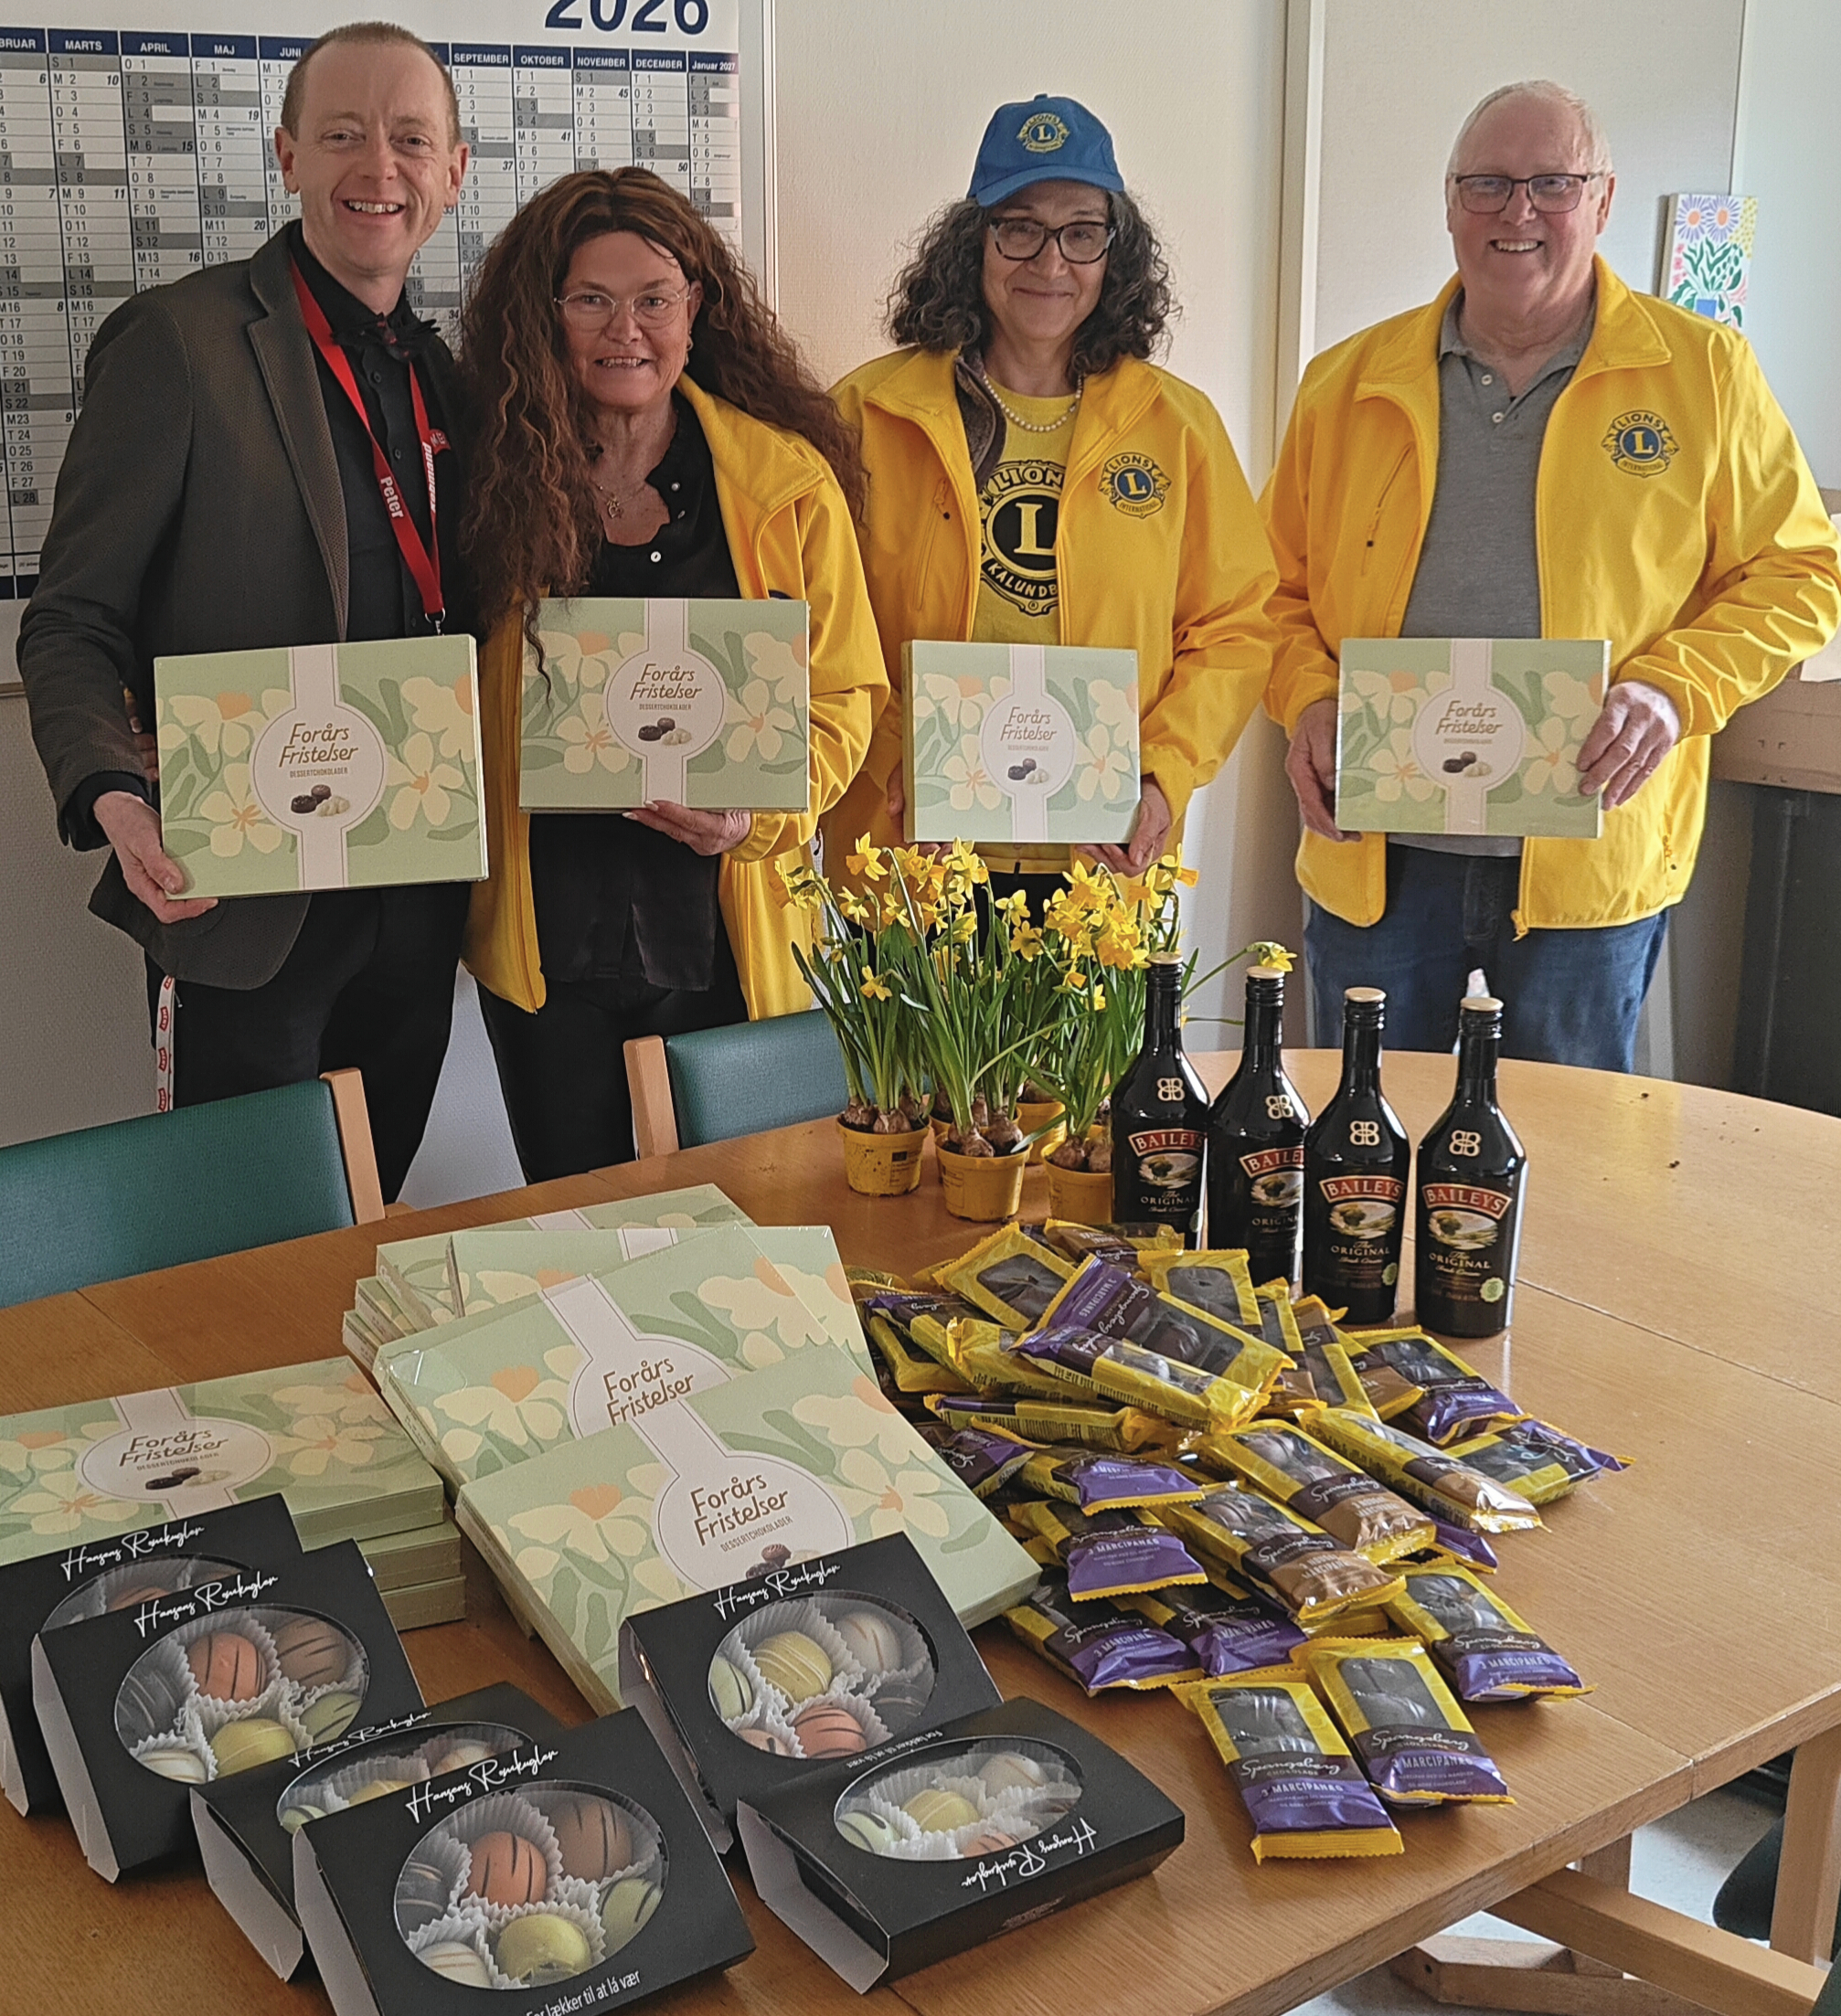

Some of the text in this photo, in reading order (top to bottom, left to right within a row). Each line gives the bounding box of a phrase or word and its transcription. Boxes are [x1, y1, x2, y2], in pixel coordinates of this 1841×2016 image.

[545, 0, 709, 35] 2026
[65, 39, 102, 51] MARTS
[140, 43, 171, 53] APRIL
[214, 45, 235, 55] MAJ
[279, 47, 302, 58] JUNI
[52, 57, 74, 69] S 1
[195, 61, 200, 70] F
[211, 61, 216, 71] 1
[454, 53, 509, 64] SEPTEMBER
[520, 56, 564, 66] OKTOBER
[577, 57, 626, 68] NOVEMBER
[635, 58, 683, 69] DECEMBER
[692, 61, 736, 72] Januar 2027
[54, 74, 119, 86] M 2 10
[577, 88, 629, 98] M 2 45
[198, 110, 259, 121] M 4 19
[518, 131, 526, 141] M
[531, 132, 537, 141] 5
[561, 132, 571, 142] 41
[693, 134, 709, 143] T 5
[1038, 125, 1051, 140] L
[130, 141, 139, 152] M
[145, 141, 152, 152] 6
[182, 141, 193, 152] 15
[200, 142, 221, 152] O 6
[473, 162, 513, 171] 7 37
[62, 188, 125, 199] M 9 11
[461, 206, 480, 215] T 10
[205, 220, 265, 230] M 11 20
[137, 251, 200, 263] M 13 16
[6, 412, 72, 425] M 23 9
[1617, 413, 1662, 428] LIONS
[9, 445, 32, 456] O 25
[1632, 431, 1655, 453] L
[1111, 455, 1150, 472] LIONS
[996, 467, 1063, 491] LION
[1124, 472, 1146, 495] L
[380, 476, 404, 518] Peter
[1014, 503, 1058, 556] L
[987, 562, 1059, 599] KALUNDB
[640, 663, 695, 682] Forårs
[630, 682, 702, 701] Fristelser
[1008, 706, 1051, 724] Forårs
[1445, 700, 1496, 718] Forårs
[290, 723, 349, 745] Forårs
[1000, 725, 1057, 741] Fristelser
[1435, 717, 1504, 735] Fristelser
[279, 744, 358, 767] Fristelser
[290, 767, 348, 779] DESSERTCHOKOLADER
[1135, 1133, 1205, 1151] BAILEYS
[1248, 1148, 1304, 1172] BAILE
[1326, 1180, 1404, 1198] BAILEYS
[1427, 1190, 1505, 1211] BAILEYS
[1331, 1246, 1390, 1256] ORIGINAL
[1429, 1253, 1491, 1268] ORIGINAL
[602, 1354, 676, 1400] Forårs
[606, 1373, 695, 1426] Fristelser
[129, 1428, 213, 1454] Forårs
[119, 1438, 229, 1467] Fristelser
[689, 1470, 768, 1517] Forårs
[694, 1488, 791, 1546] Fristelser
[720, 1514, 793, 1553] DESSERTCHOKOLADER
[60, 1523, 205, 1581] Hansens Romkugler
[713, 1561, 840, 1620] Hansens Romkugler
[134, 1572, 279, 1638] Hansens Romkugler
[1371, 1730, 1469, 1751] Spangsberg
[1241, 1757, 1341, 1779] Spangsberg
[405, 1745, 559, 1823] Hansens Romkugler
[545, 1994, 583, 2016] lækker
[583, 1985, 596, 2005] til
[596, 1982, 609, 2000] at
[619, 1970, 641, 1989] vær
